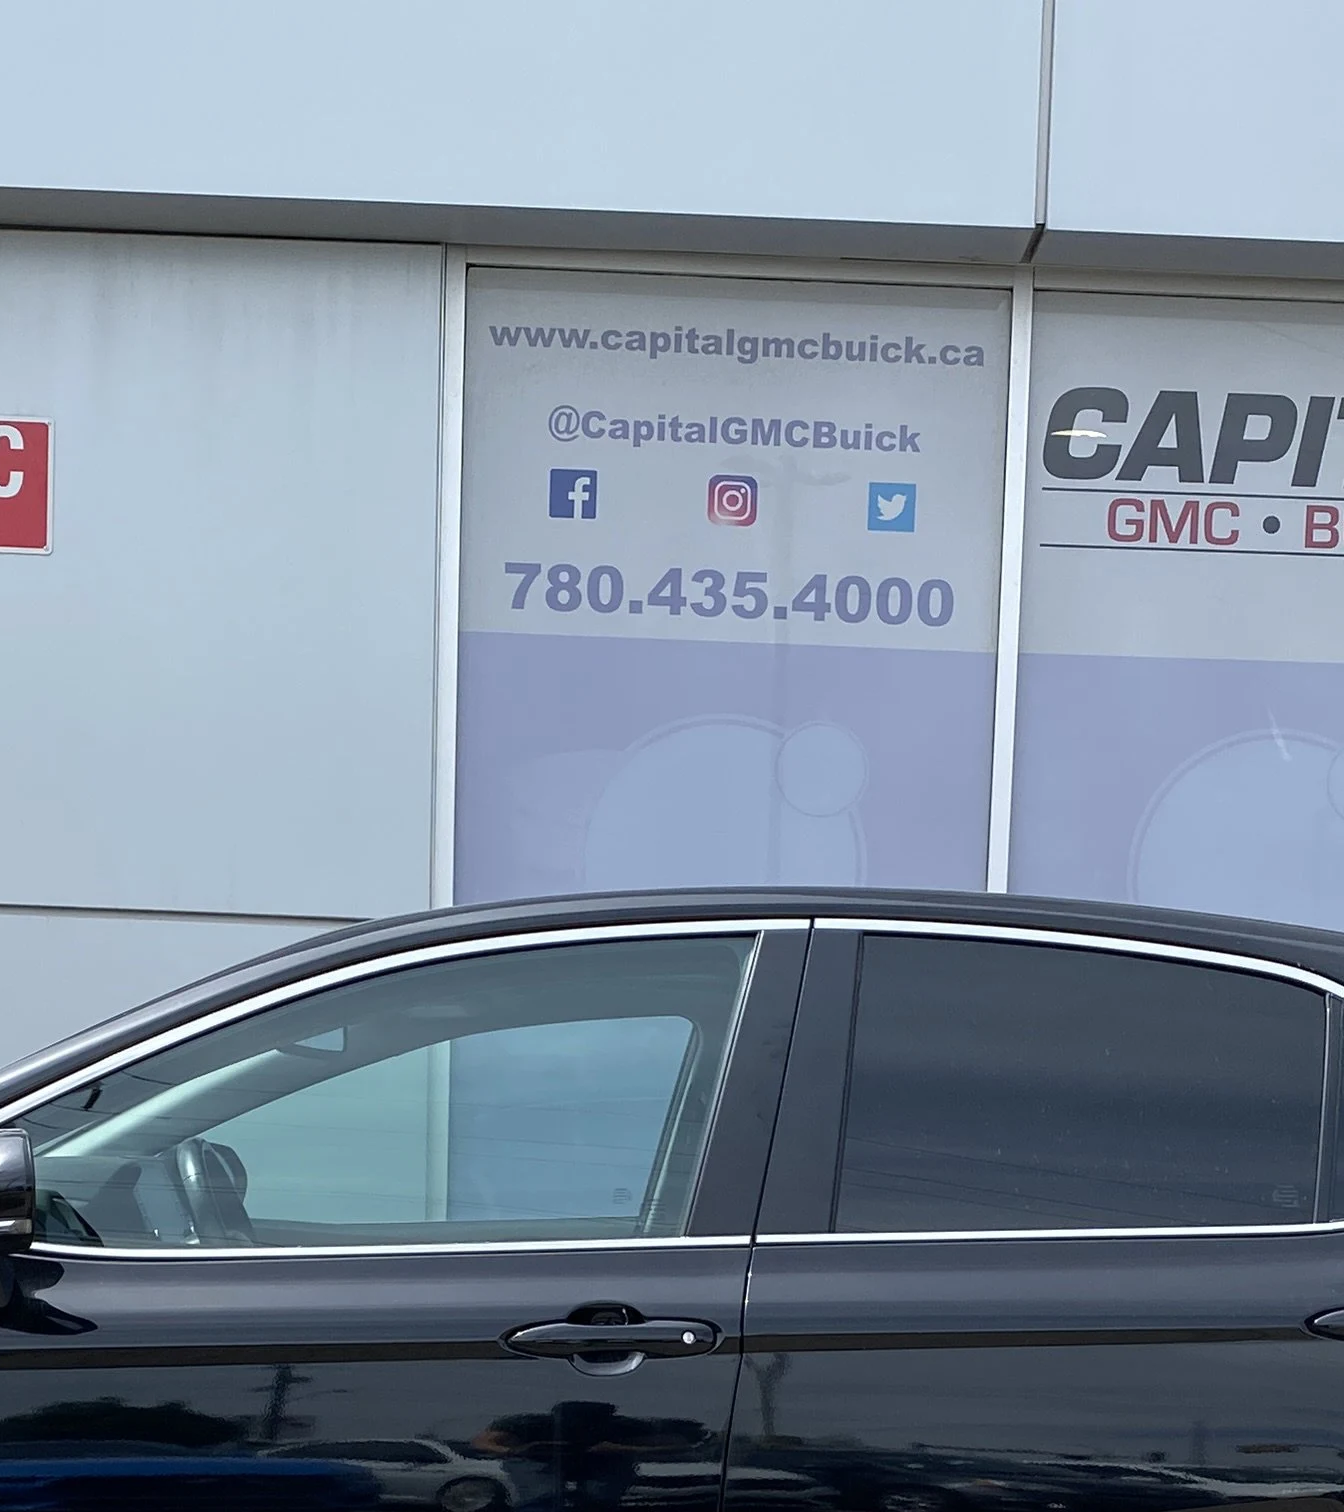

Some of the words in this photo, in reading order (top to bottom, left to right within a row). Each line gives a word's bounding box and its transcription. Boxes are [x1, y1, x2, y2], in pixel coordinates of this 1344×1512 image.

[488, 323, 985, 367] www.capitalgmcbuick.ca
[548, 404, 921, 453] @CapitalGMCBuick
[1106, 497, 1241, 545] GMC
[503, 561, 956, 627] 780.435.4000
